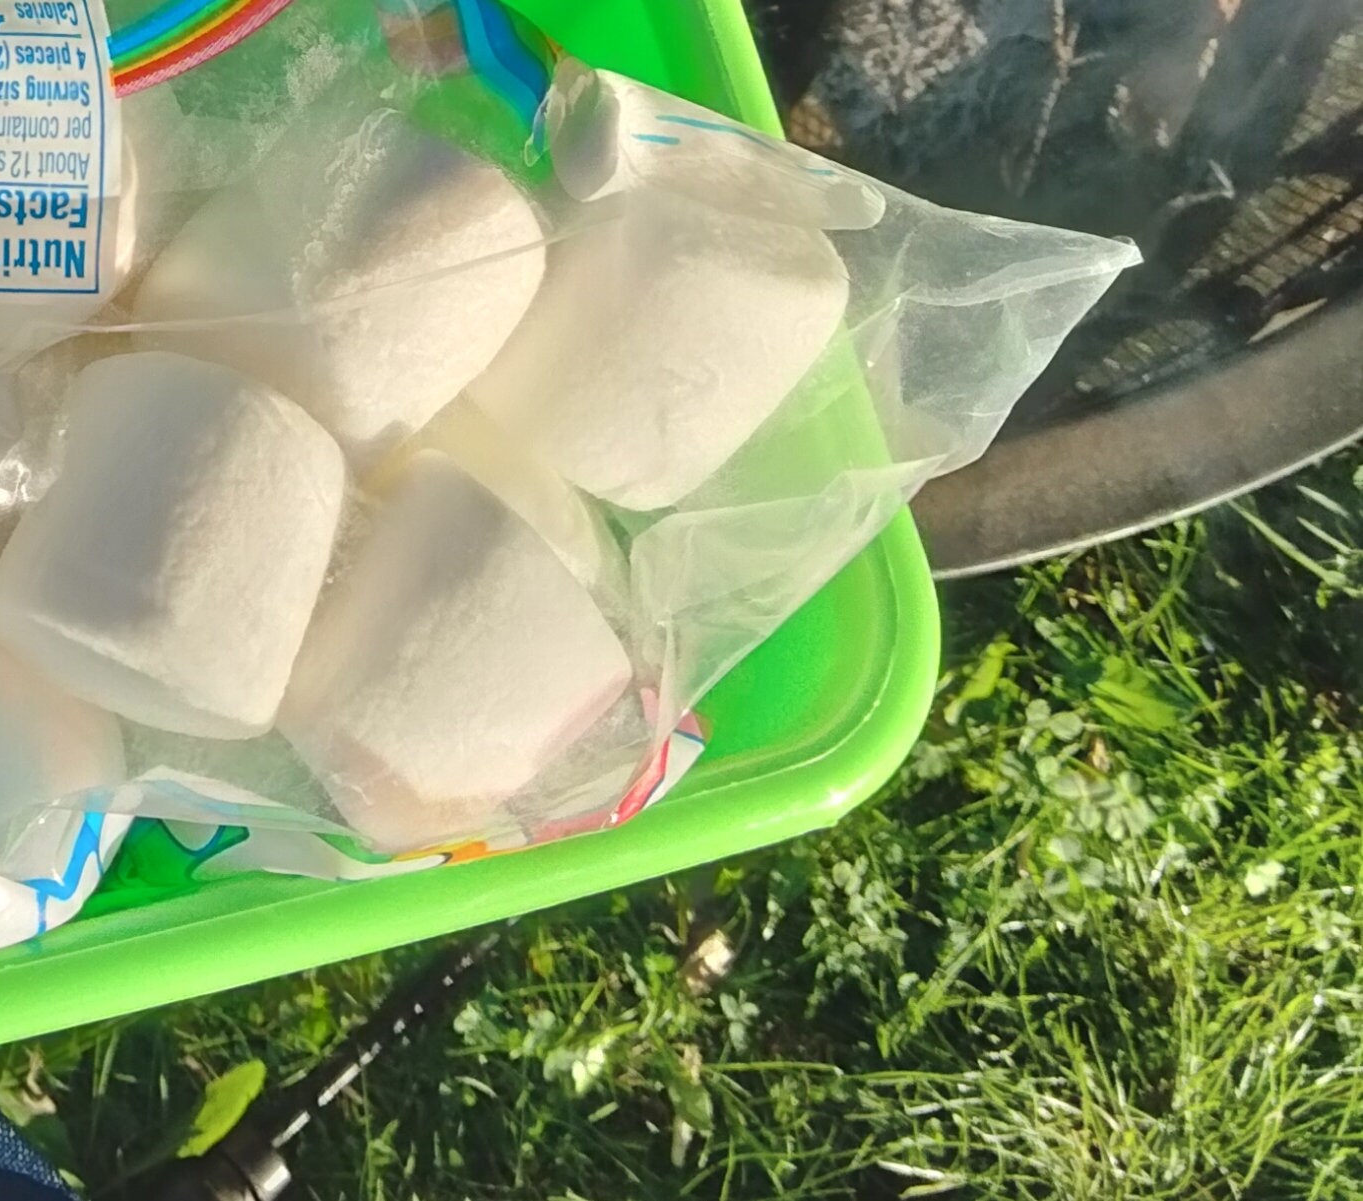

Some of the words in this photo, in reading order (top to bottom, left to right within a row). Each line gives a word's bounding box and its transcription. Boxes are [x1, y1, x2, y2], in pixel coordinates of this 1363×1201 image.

[14, 2, 79, 26] Calories
[15, 42, 71, 70] pieces
[76, 49, 86, 70] 4
[26, 75, 90, 107] Serving
[64, 111, 92, 139] per
[10, 151, 31, 178] 12
[38, 151, 91, 181] About
